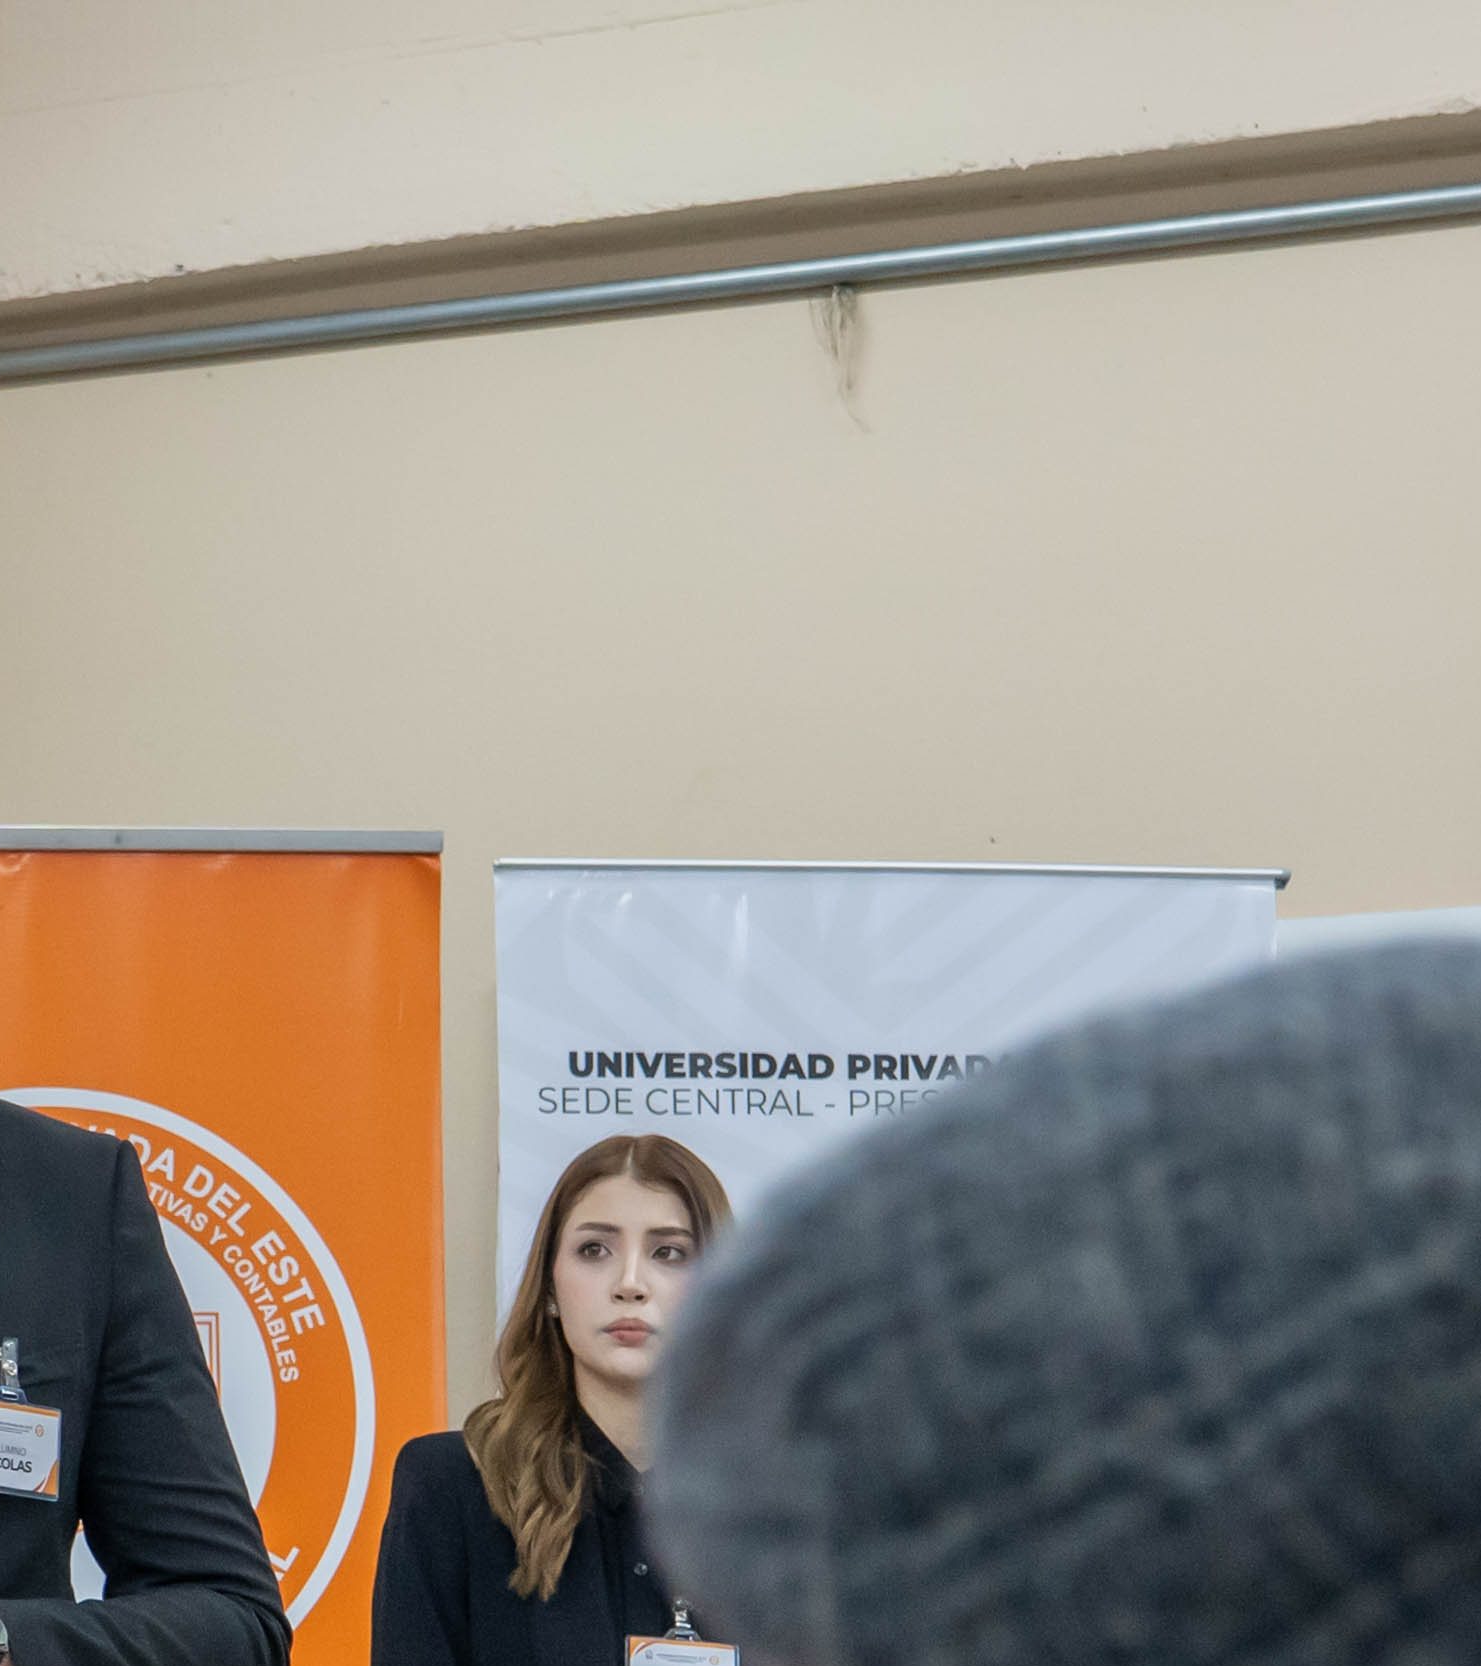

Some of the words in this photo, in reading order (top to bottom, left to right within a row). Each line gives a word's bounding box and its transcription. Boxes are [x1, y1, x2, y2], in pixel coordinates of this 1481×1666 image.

[539, 1087, 633, 1115] SEDE
[646, 1088, 813, 1116] CENTRAL
[569, 1052, 834, 1079] UNIVERSIDAD
[848, 1054, 997, 1081] PRIVAD
[183, 1164, 252, 1237] DEL
[250, 1230, 326, 1335] ESTE
[208, 1226, 227, 1246] Y
[223, 1244, 299, 1383] CONTABLES
